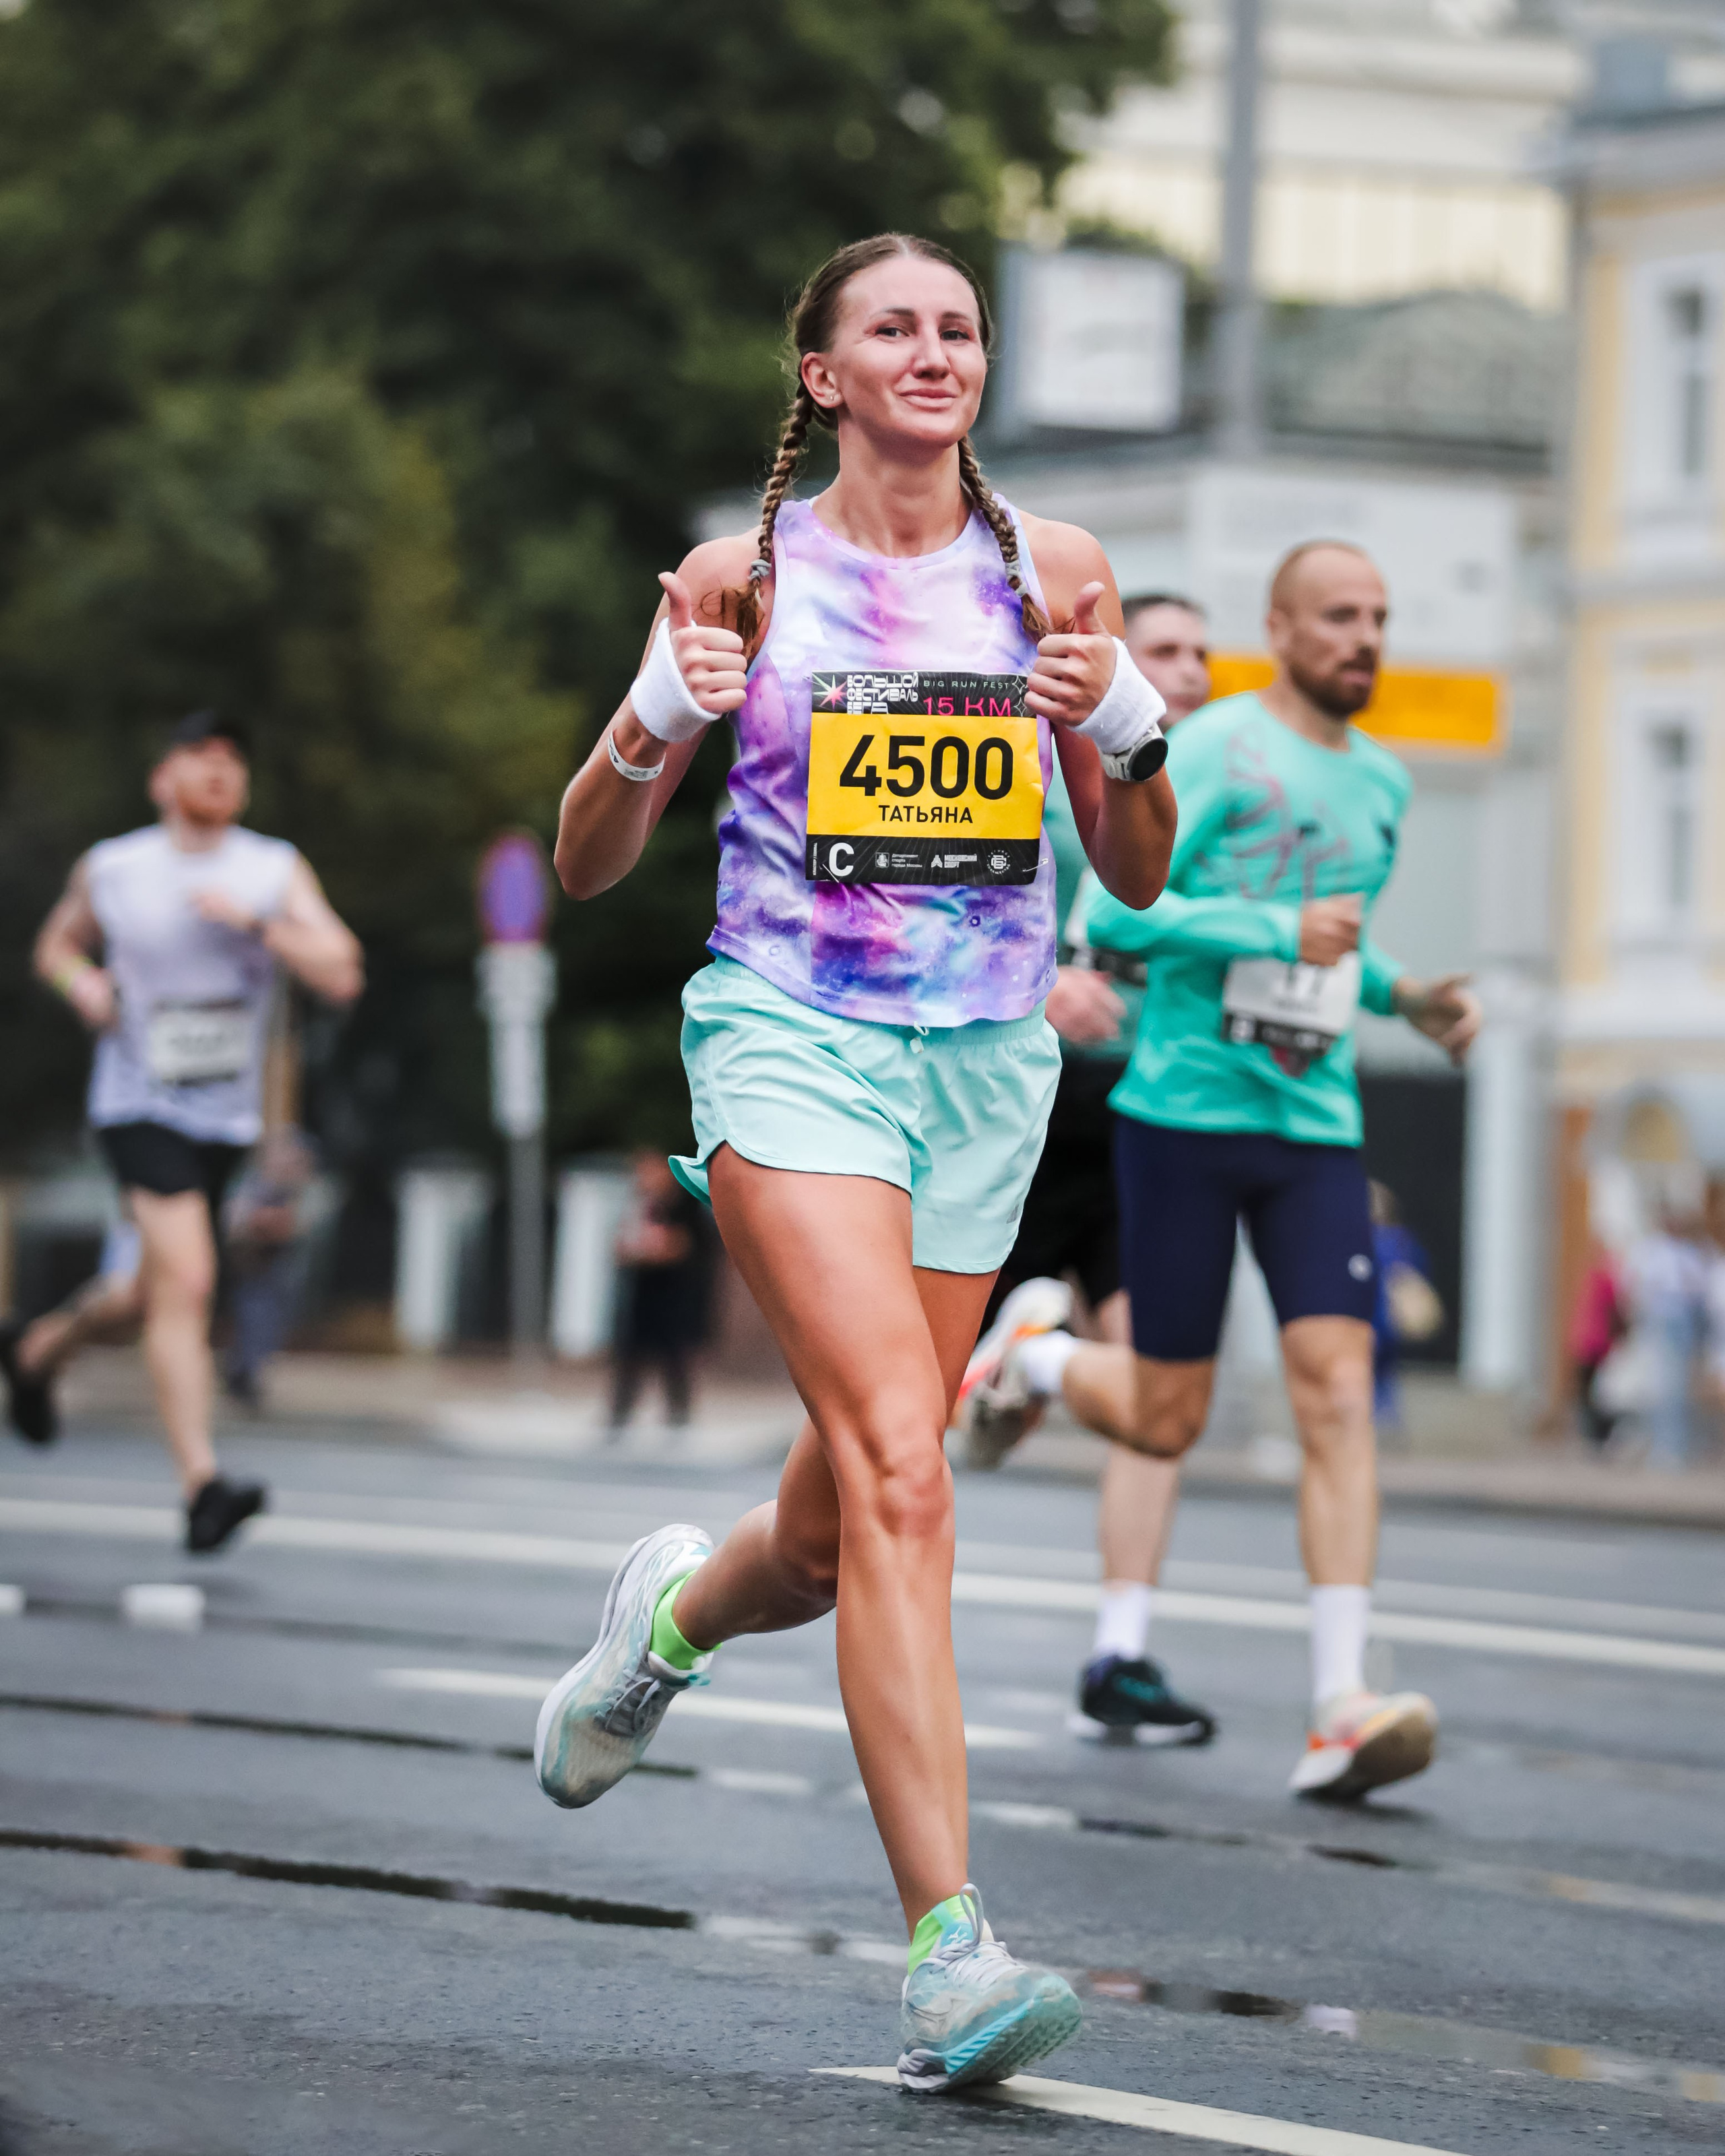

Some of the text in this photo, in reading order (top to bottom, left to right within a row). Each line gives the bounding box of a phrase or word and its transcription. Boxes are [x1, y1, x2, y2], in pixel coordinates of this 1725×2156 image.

[847, 672, 918, 687] БОЛЬШОЙ
[847, 688, 918, 702] ФЕСТИВАЛЬ
[847, 701, 889, 714] БЕГА
[923, 696, 954, 716] 15
[840, 734, 1013, 800] 4500
[878, 805, 973, 823] ТАТЬЯНА
[829, 842, 854, 877] C
